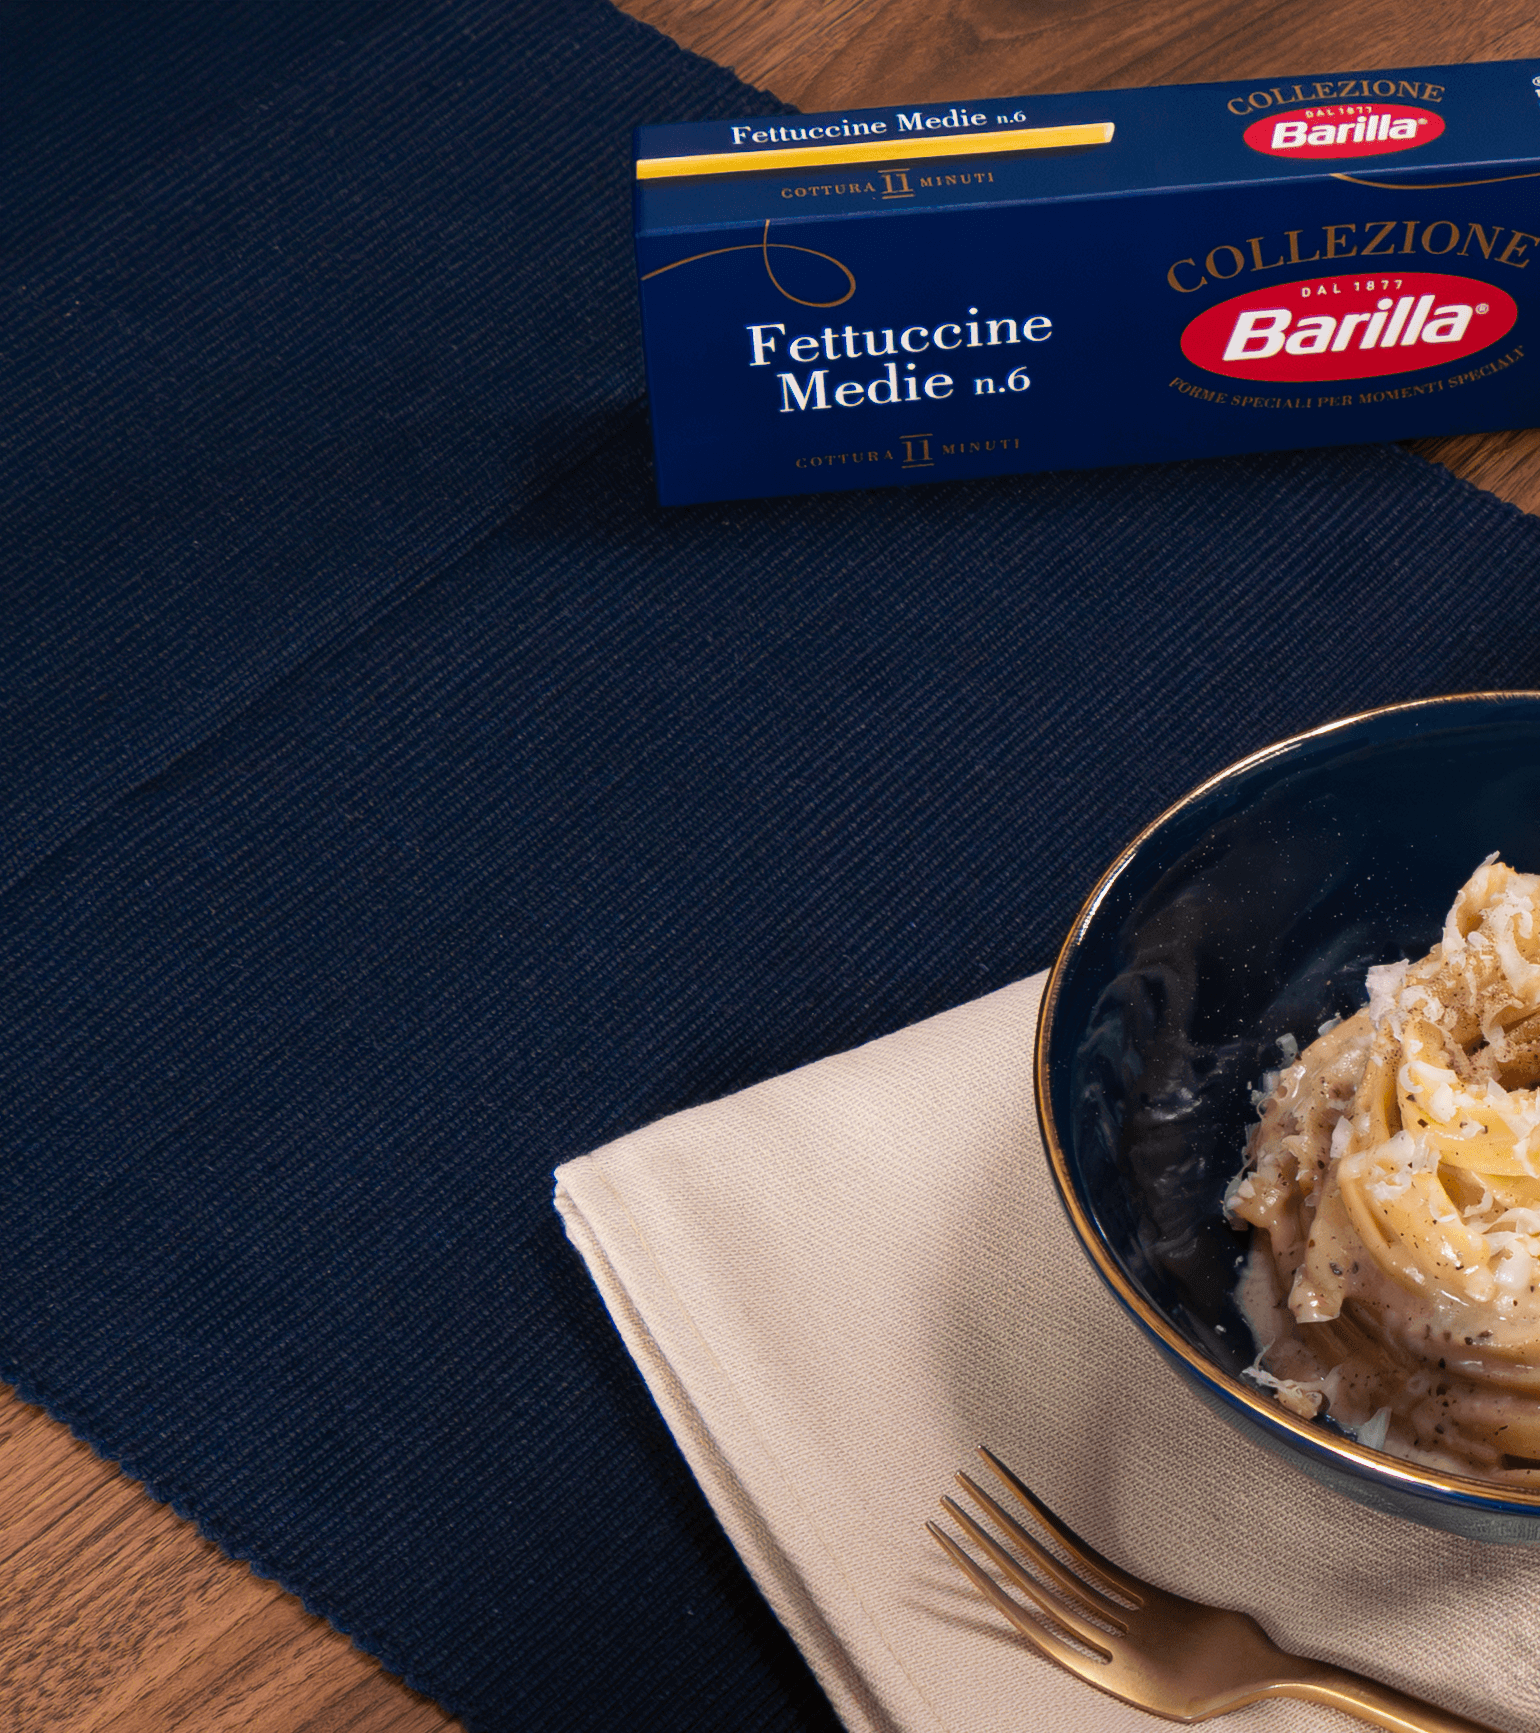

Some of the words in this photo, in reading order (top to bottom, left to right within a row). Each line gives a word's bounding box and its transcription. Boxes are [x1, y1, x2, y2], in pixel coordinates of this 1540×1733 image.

[1227, 80, 1445, 115] COLLEZIONE
[1306, 109, 1335, 118] DAL
[1339, 106, 1373, 115] 1877
[731, 118, 887, 145] Fettuccine
[897, 109, 987, 133] Medie
[997, 110, 1027, 124] n.6
[781, 180, 876, 198] COTTURA
[920, 171, 994, 188] MINUTI
[1167, 220, 1540, 294] COLLEZIONE
[1301, 284, 1341, 298] DAL
[1354, 279, 1403, 292] 1877
[746, 307, 1053, 366] Fettuccine
[777, 363, 953, 412] Medie
[974, 366, 1031, 395] n.6
[1169, 376, 1229, 405] FORME
[1231, 393, 1312, 409] SPECIALI
[1317, 394, 1353, 408] PER
[1359, 381, 1444, 404] MOMENTI
[795, 449, 893, 468] COTTURA
[942, 438, 1020, 455] MINUTI
